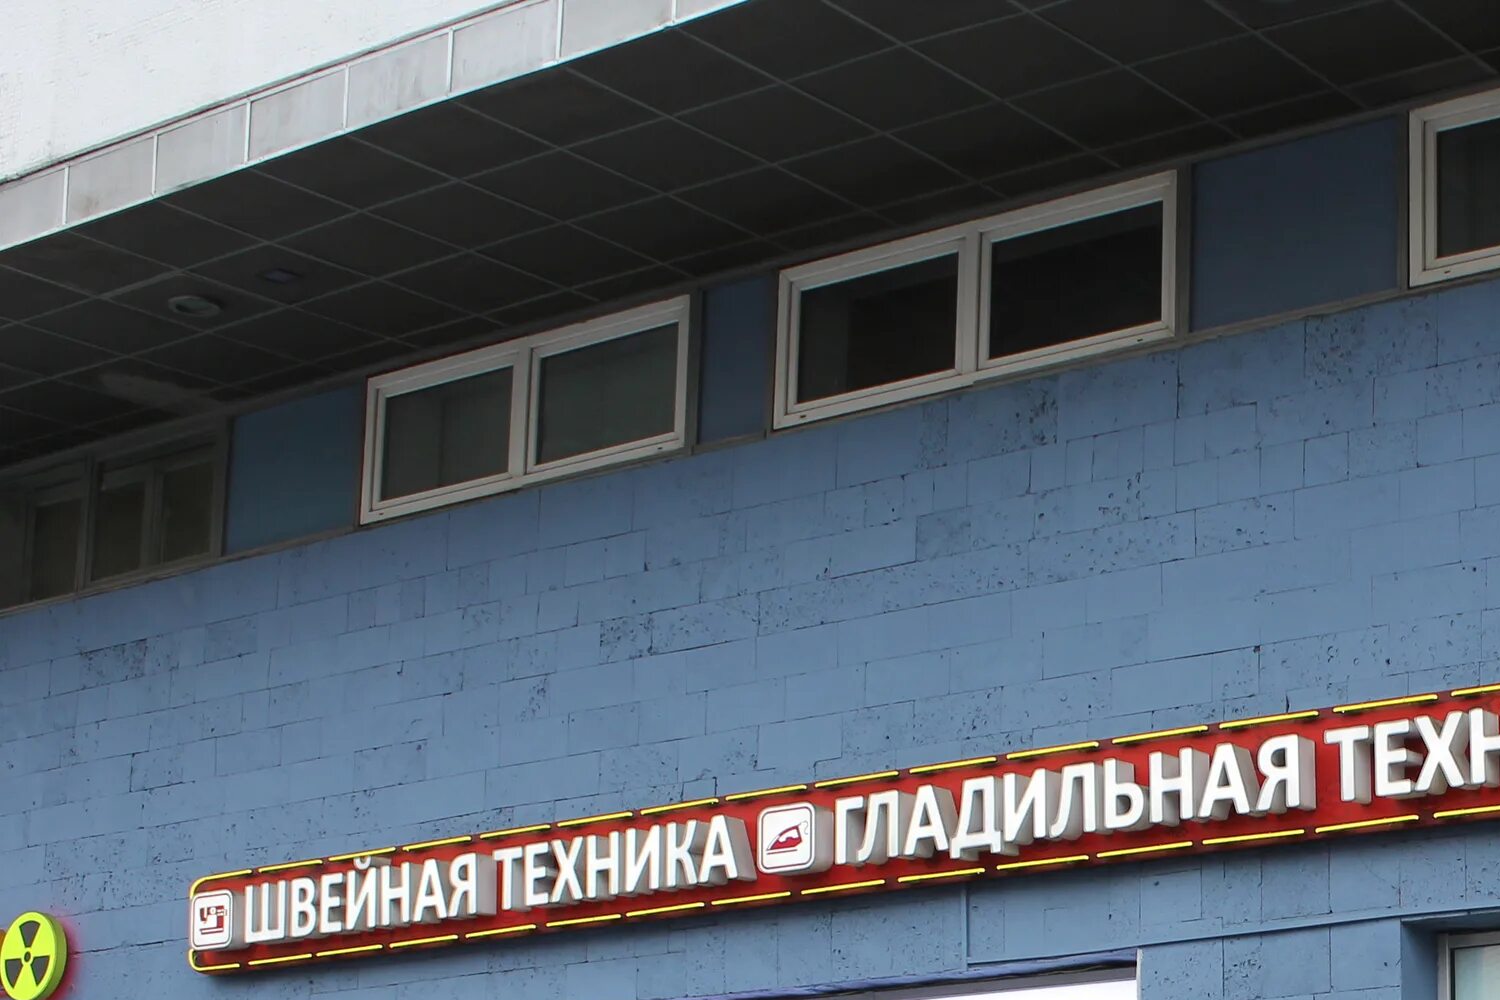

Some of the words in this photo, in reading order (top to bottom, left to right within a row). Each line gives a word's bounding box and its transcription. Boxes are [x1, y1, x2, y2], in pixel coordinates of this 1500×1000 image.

[244, 852, 478, 945] ШВЕЙНАЯ
[494, 814, 742, 912] ТЕХНИКА
[834, 732, 1304, 866] ГЛАДИЛЬНАЯ
